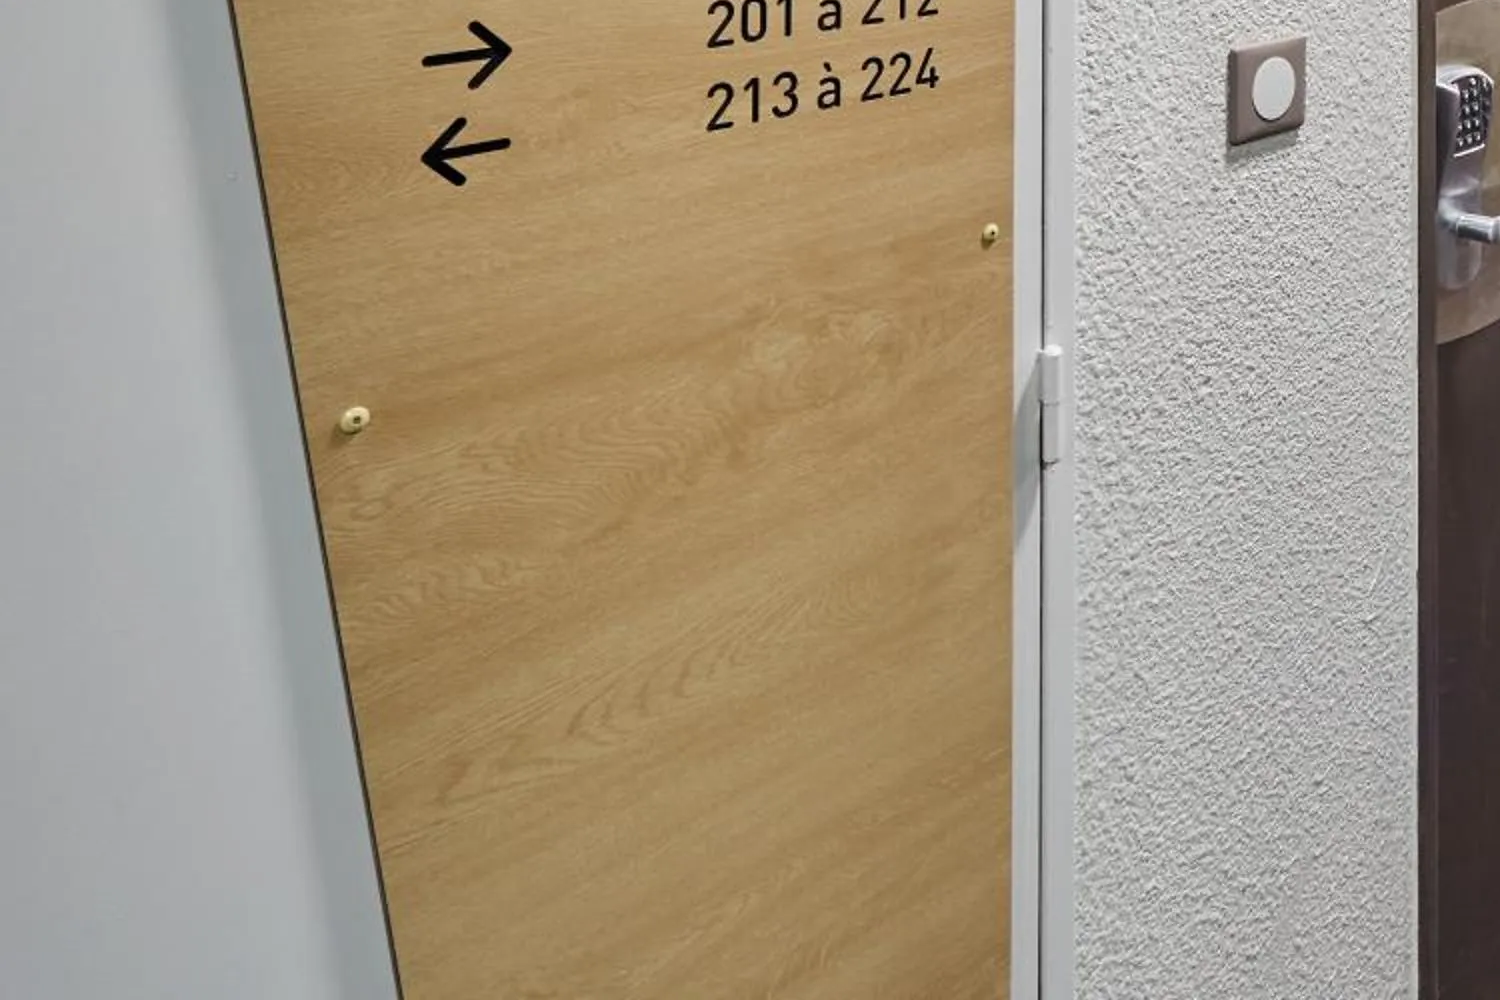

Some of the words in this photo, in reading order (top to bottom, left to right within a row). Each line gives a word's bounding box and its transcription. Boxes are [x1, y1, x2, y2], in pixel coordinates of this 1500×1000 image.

[706, 71, 799, 132] 213
[816, 62, 842, 110] à
[860, 48, 939, 102] 224
